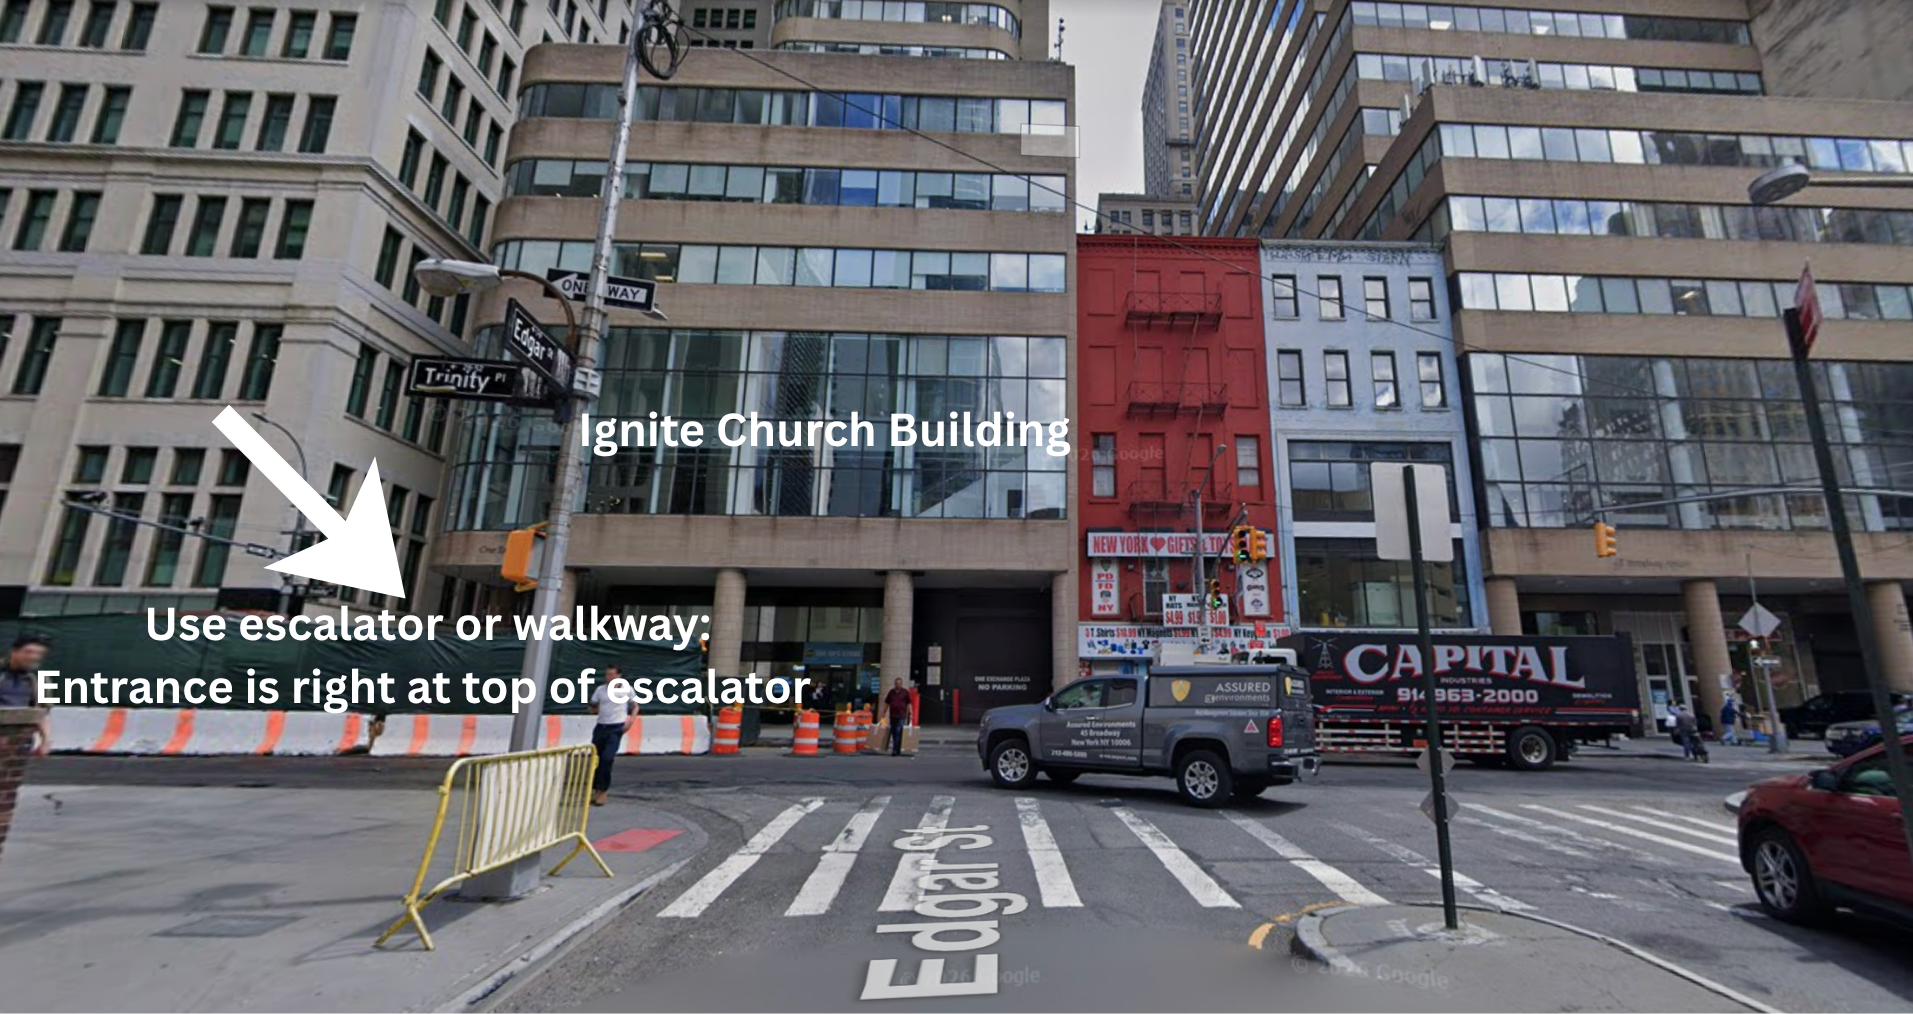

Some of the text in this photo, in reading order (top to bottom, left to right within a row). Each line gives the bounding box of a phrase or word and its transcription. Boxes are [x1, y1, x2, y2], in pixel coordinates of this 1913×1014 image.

[608, 285, 640, 300] WAY
[514, 318, 546, 360] Edgar
[425, 367, 490, 393] Trinity
[495, 374, 507, 383] Pl
[1093, 536, 1117, 553] NEW
[1120, 536, 1149, 554] YORK
[1167, 536, 1197, 554] GIFTS
[1166, 610, 1183, 625] $4.99
[1188, 610, 1202, 625] $1.9
[1116, 627, 1137, 638] $10.99
[1138, 627, 1145, 638] NY
[1233, 628, 1241, 637] NY
[1343, 643, 1586, 690] CAPITAL
[978, 683, 1028, 691] NO PARKING
[1215, 682, 1270, 693] ASSURED
[1214, 693, 1270, 702] environments
[1066, 721, 1136, 729] Assured Environments
[1089, 729, 1121, 738] Broadway
